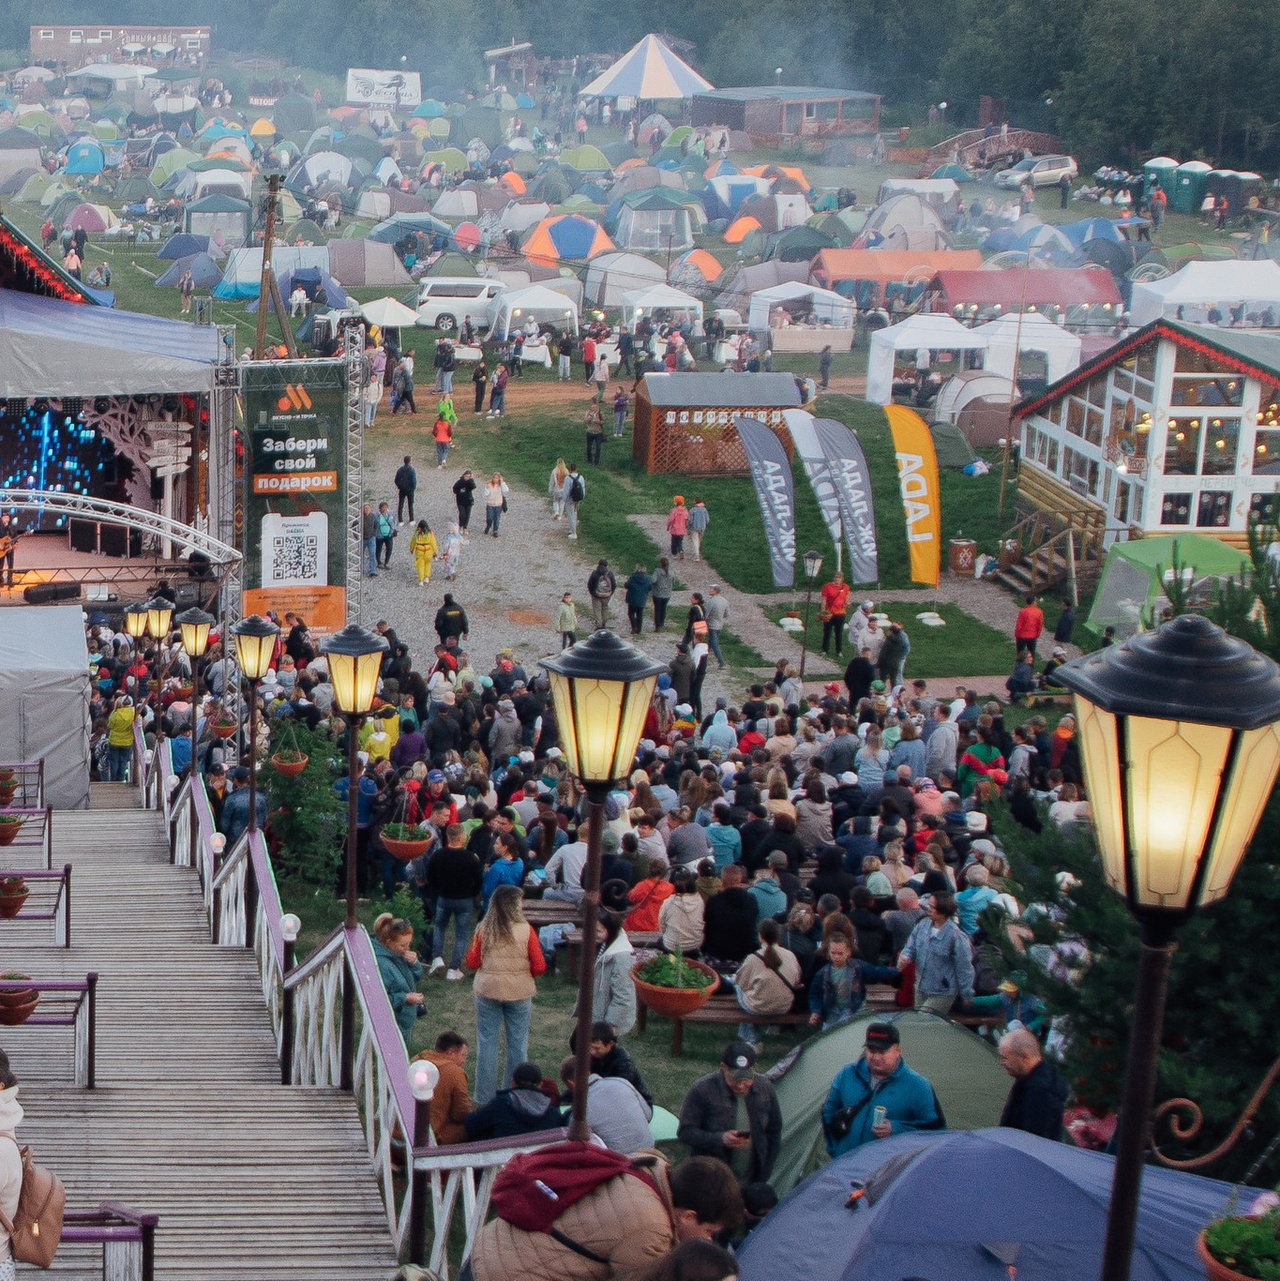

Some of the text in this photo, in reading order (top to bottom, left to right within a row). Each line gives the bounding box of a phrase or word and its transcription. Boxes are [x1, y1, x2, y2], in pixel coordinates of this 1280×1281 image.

[262, 437, 328, 453] Забери
[274, 454, 317, 470] свой
[257, 475, 333, 491] подарок
